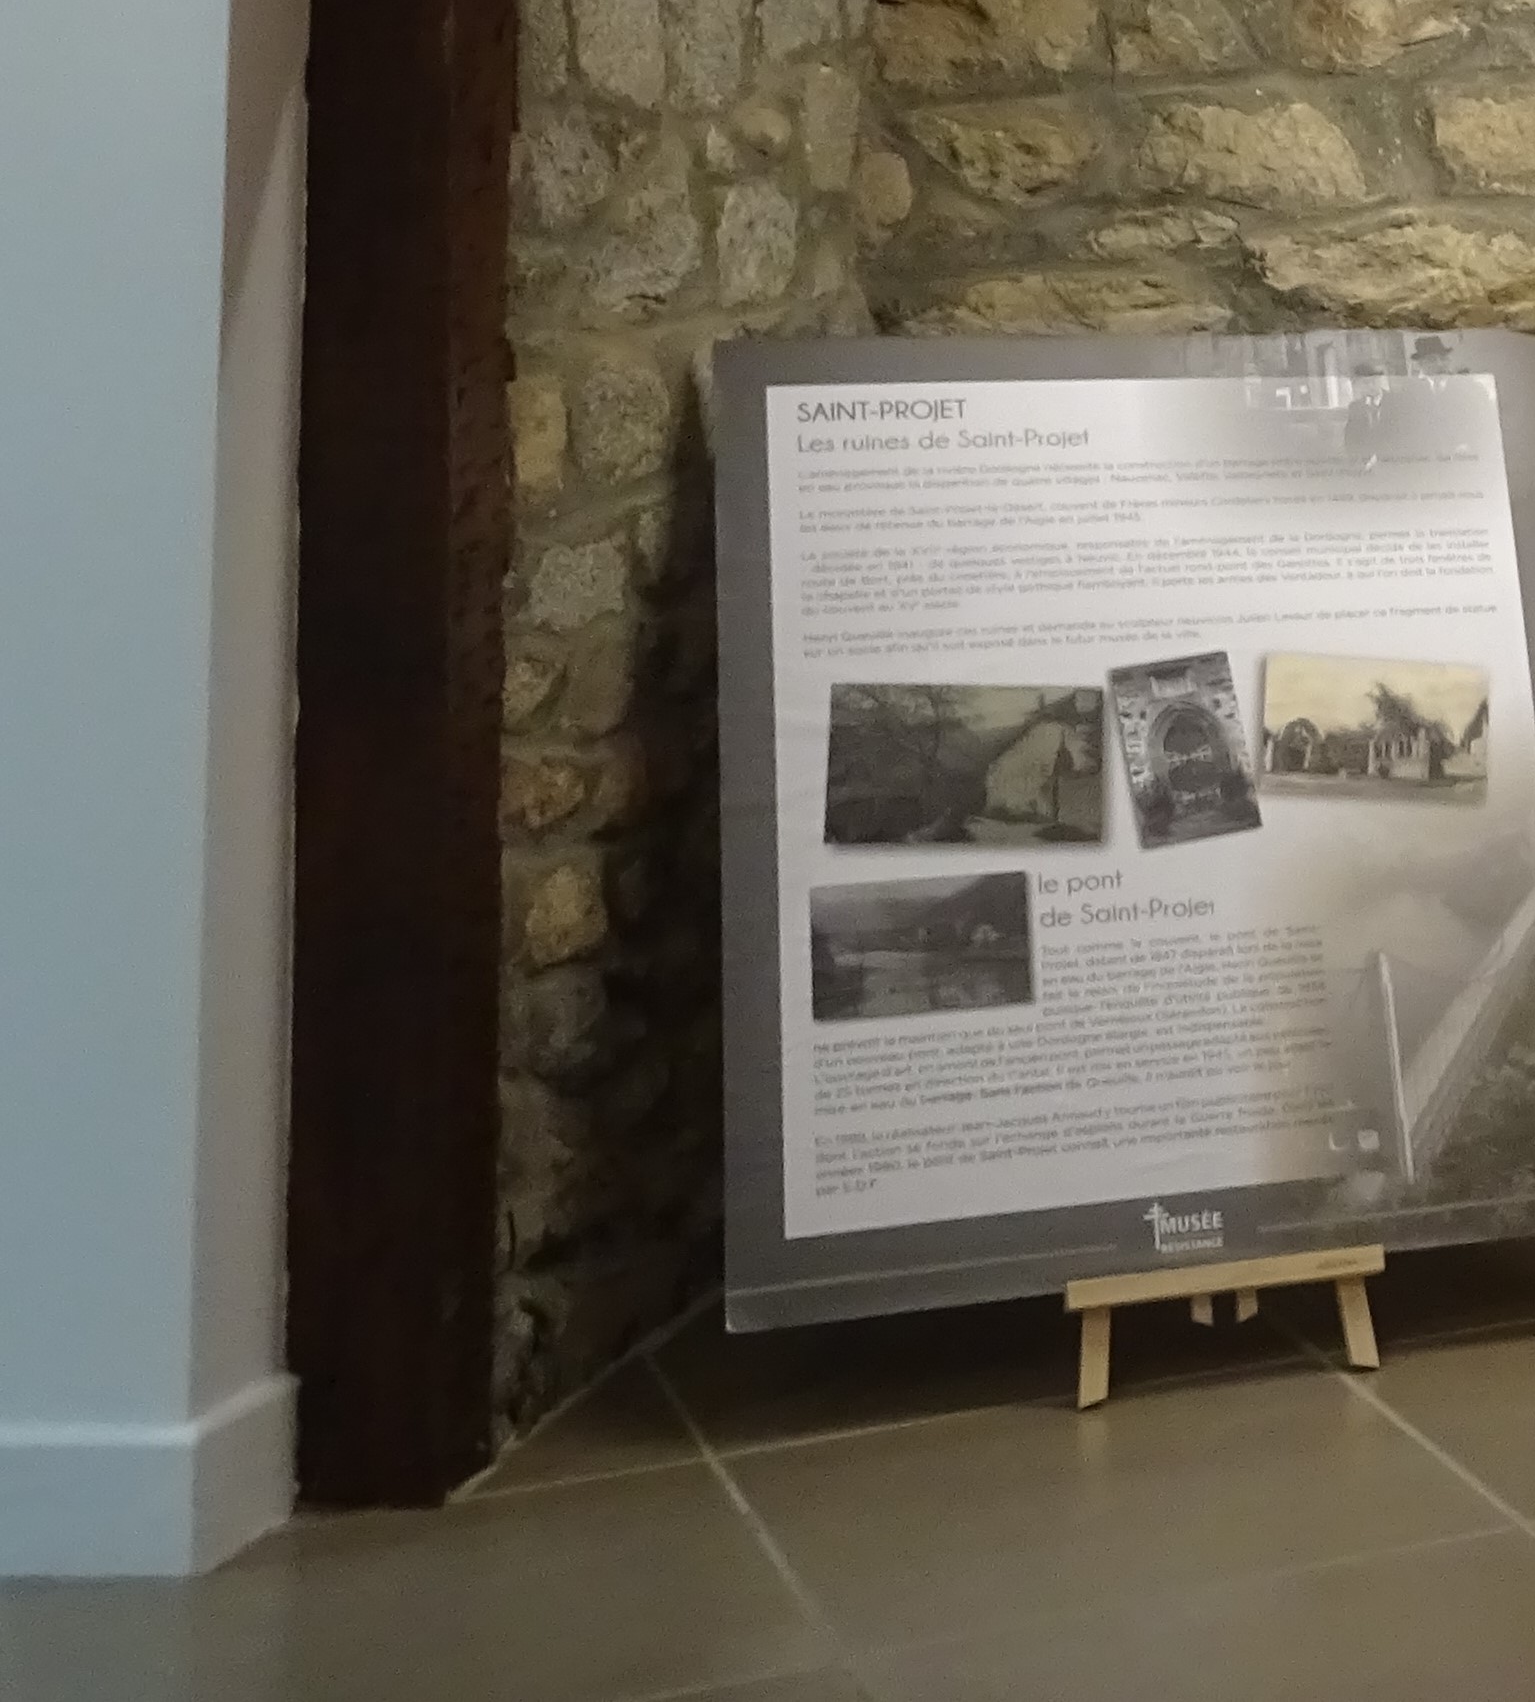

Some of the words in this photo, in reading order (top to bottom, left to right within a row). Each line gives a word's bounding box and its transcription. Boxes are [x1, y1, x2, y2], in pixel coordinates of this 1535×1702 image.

[797, 398, 966, 423] SAINT-PROJET
[797, 434, 835, 453] Les
[843, 435, 909, 451] ruines
[918, 431, 950, 449] de
[957, 428, 1089, 450] Saint-Projet
[1038, 871, 1059, 894] le
[1067, 869, 1123, 895] pont
[1160, 1208, 1224, 1234] MUSÉE
